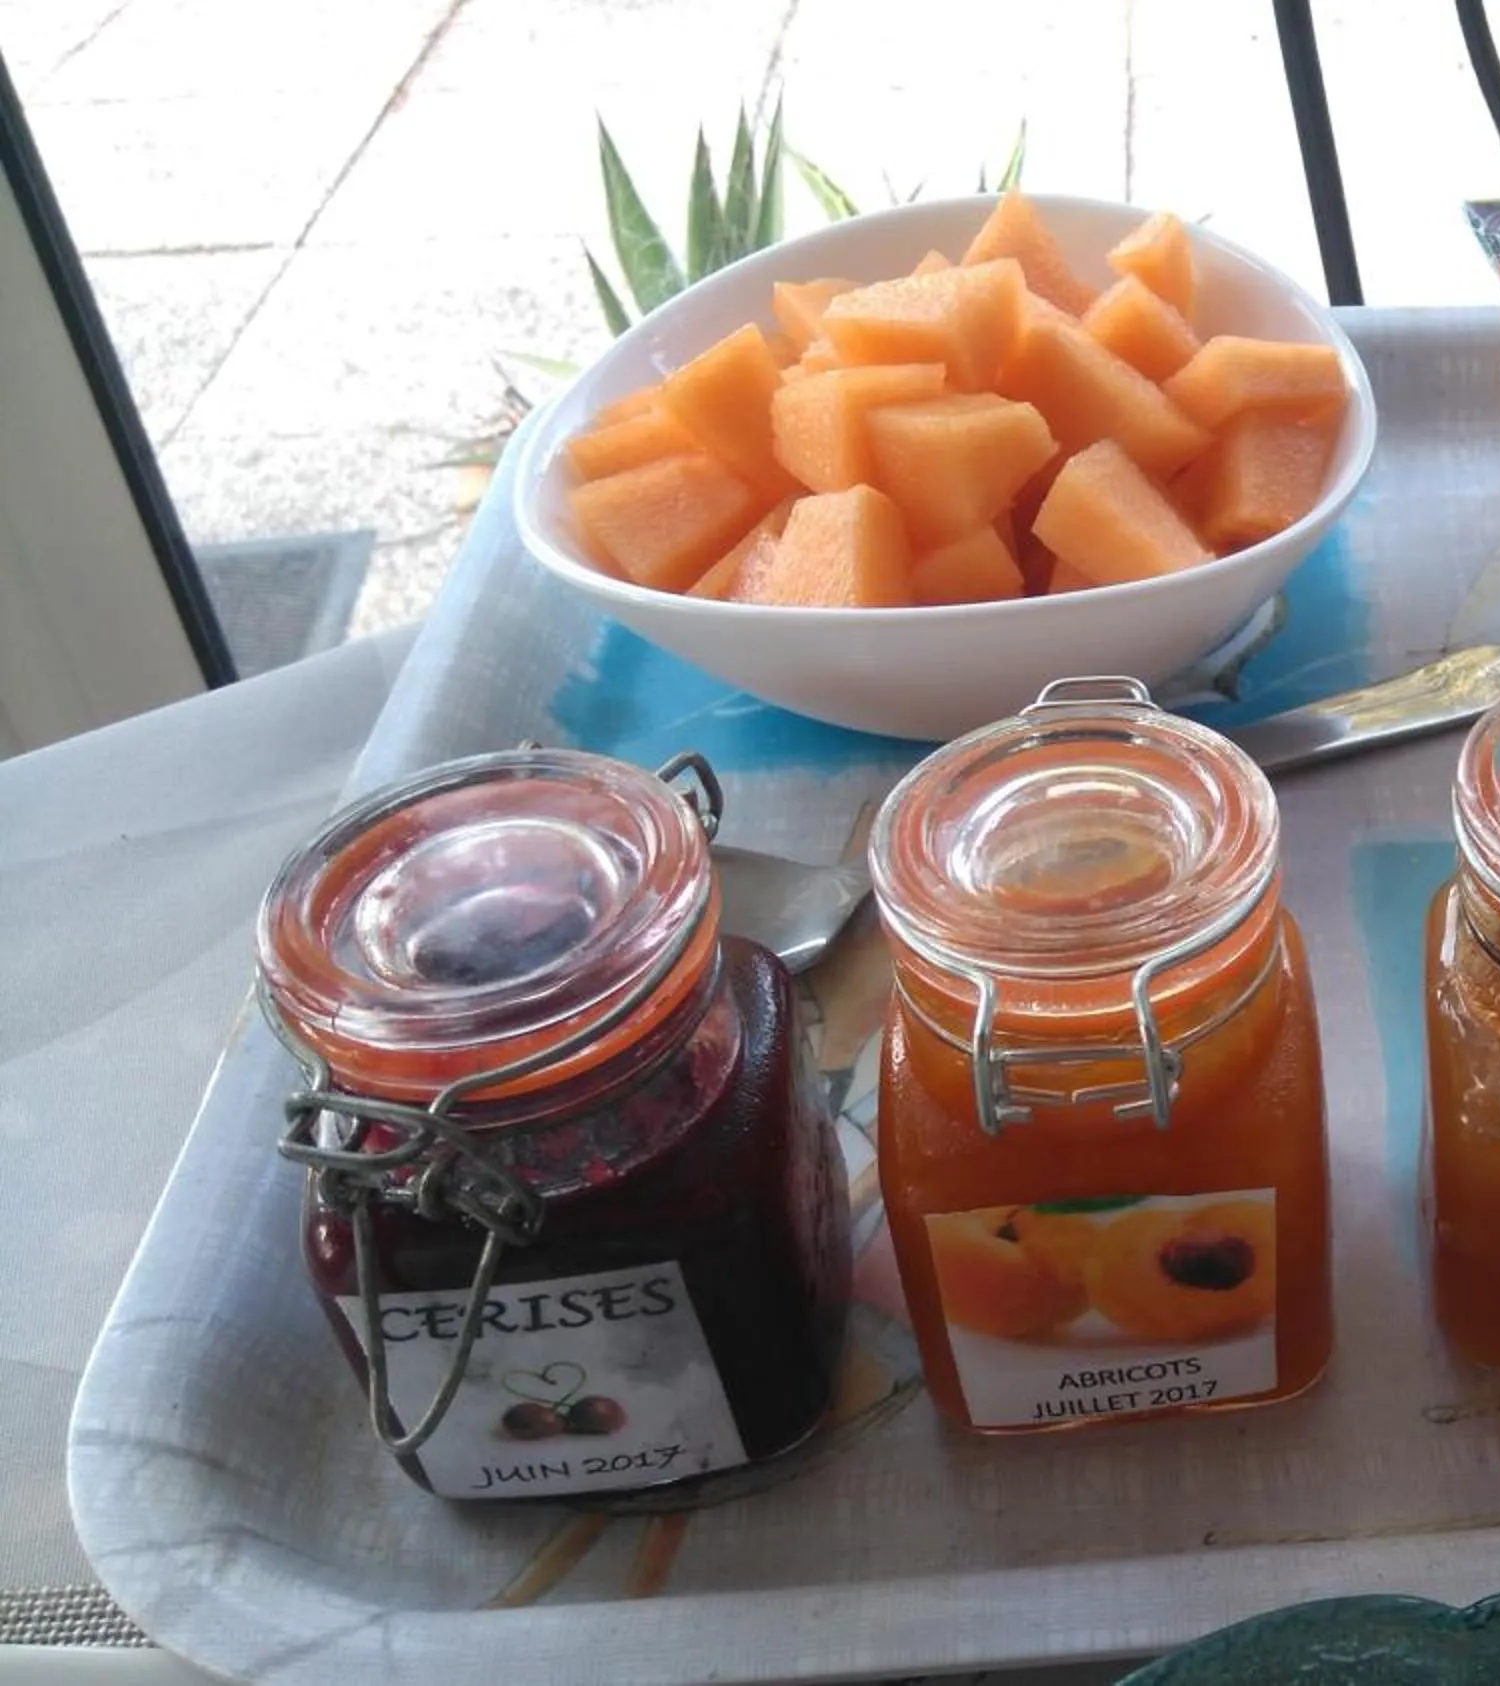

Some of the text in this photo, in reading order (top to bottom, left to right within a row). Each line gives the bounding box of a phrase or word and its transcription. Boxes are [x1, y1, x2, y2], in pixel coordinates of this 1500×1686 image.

[379, 1277, 677, 1342] CERISES
[1058, 1356, 1202, 1391] ABRICOTS
[1032, 1380, 1219, 1420] JUILLET 2017
[471, 1444, 686, 1490] JUIN 2017
